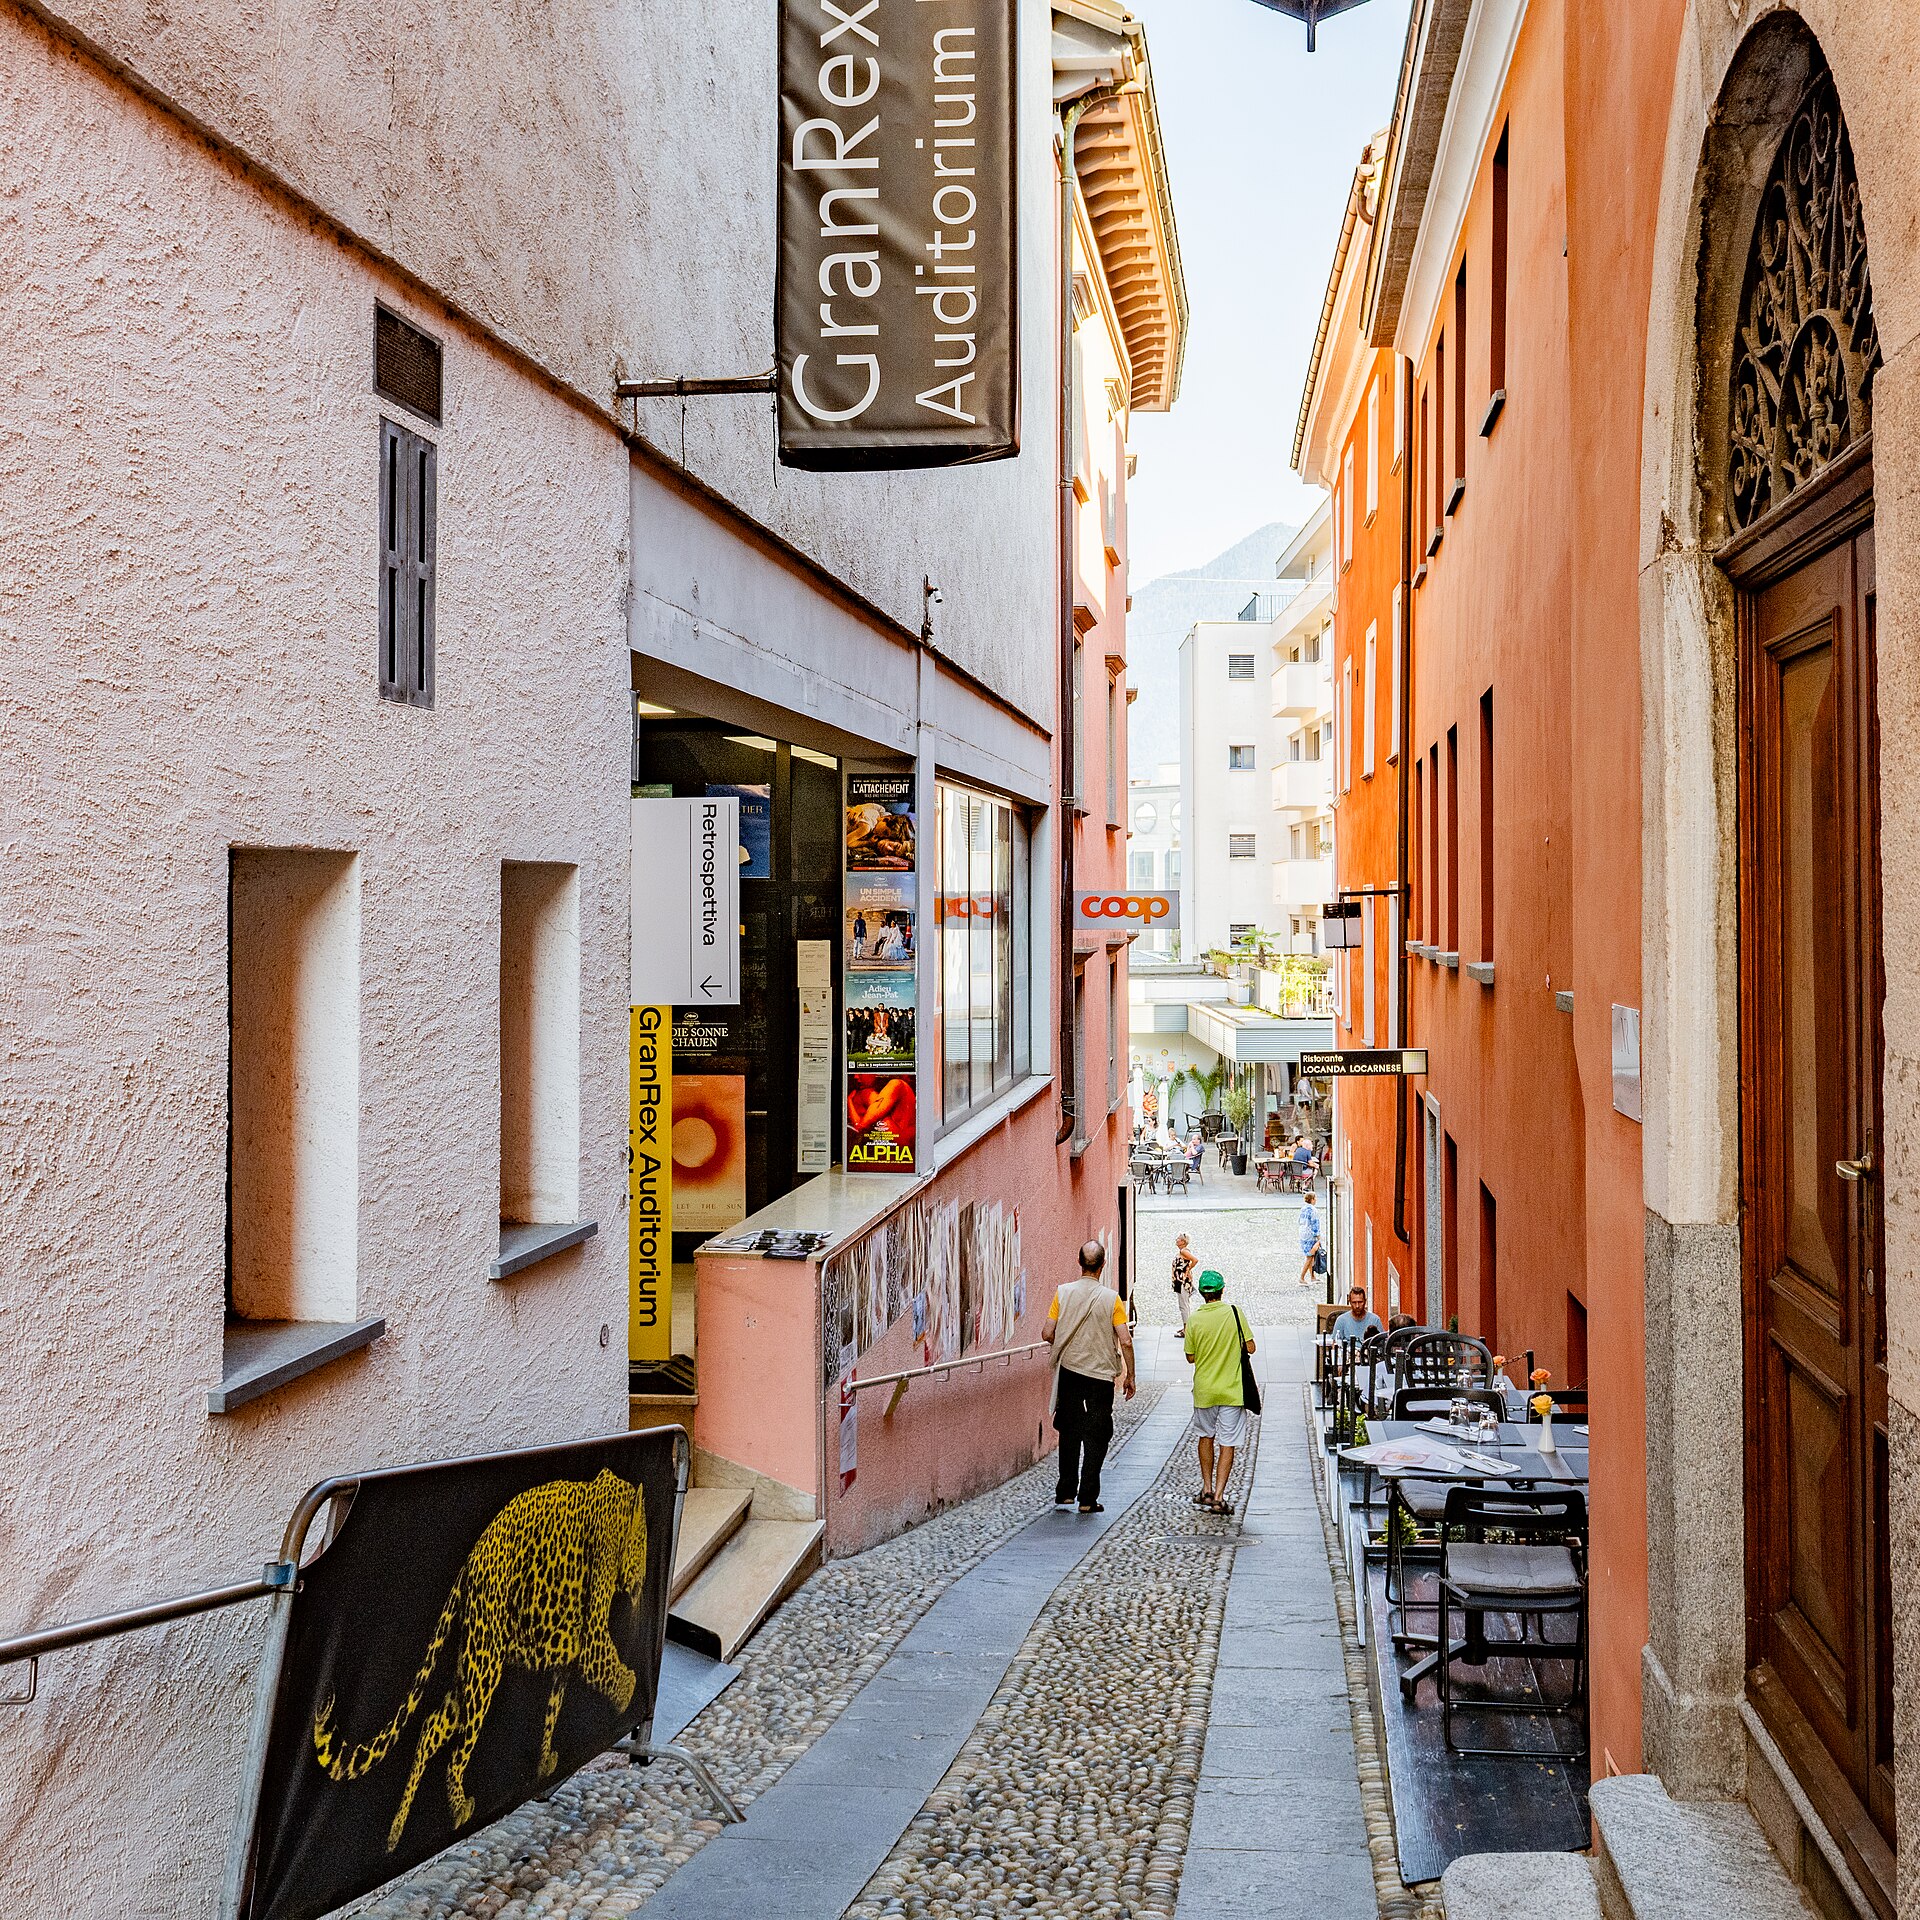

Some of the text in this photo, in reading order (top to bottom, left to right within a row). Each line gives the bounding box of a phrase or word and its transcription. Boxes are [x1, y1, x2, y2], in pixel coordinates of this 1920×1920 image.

[792, 0, 881, 422] GranRex
[915, 27, 977, 424] Auditorium
[853, 784, 910, 794] L'ATTACHEMENT
[740, 805, 763, 814] TIER
[700, 804, 718, 946] Retrospettiva
[1081, 896, 1170, 924] coop
[869, 985, 892, 993] Adieu
[862, 991, 899, 999] Jean-Pat
[690, 1027, 729, 1037] SONNE
[671, 1038, 718, 1047] CHAUEN
[1302, 1054, 1344, 1063] Ristorante
[1303, 1064, 1402, 1074] LOCANDA LOCARNESE
[849, 1145, 913, 1161] ALPHA
[639, 1007, 661, 1327] GranRex Auditorium
